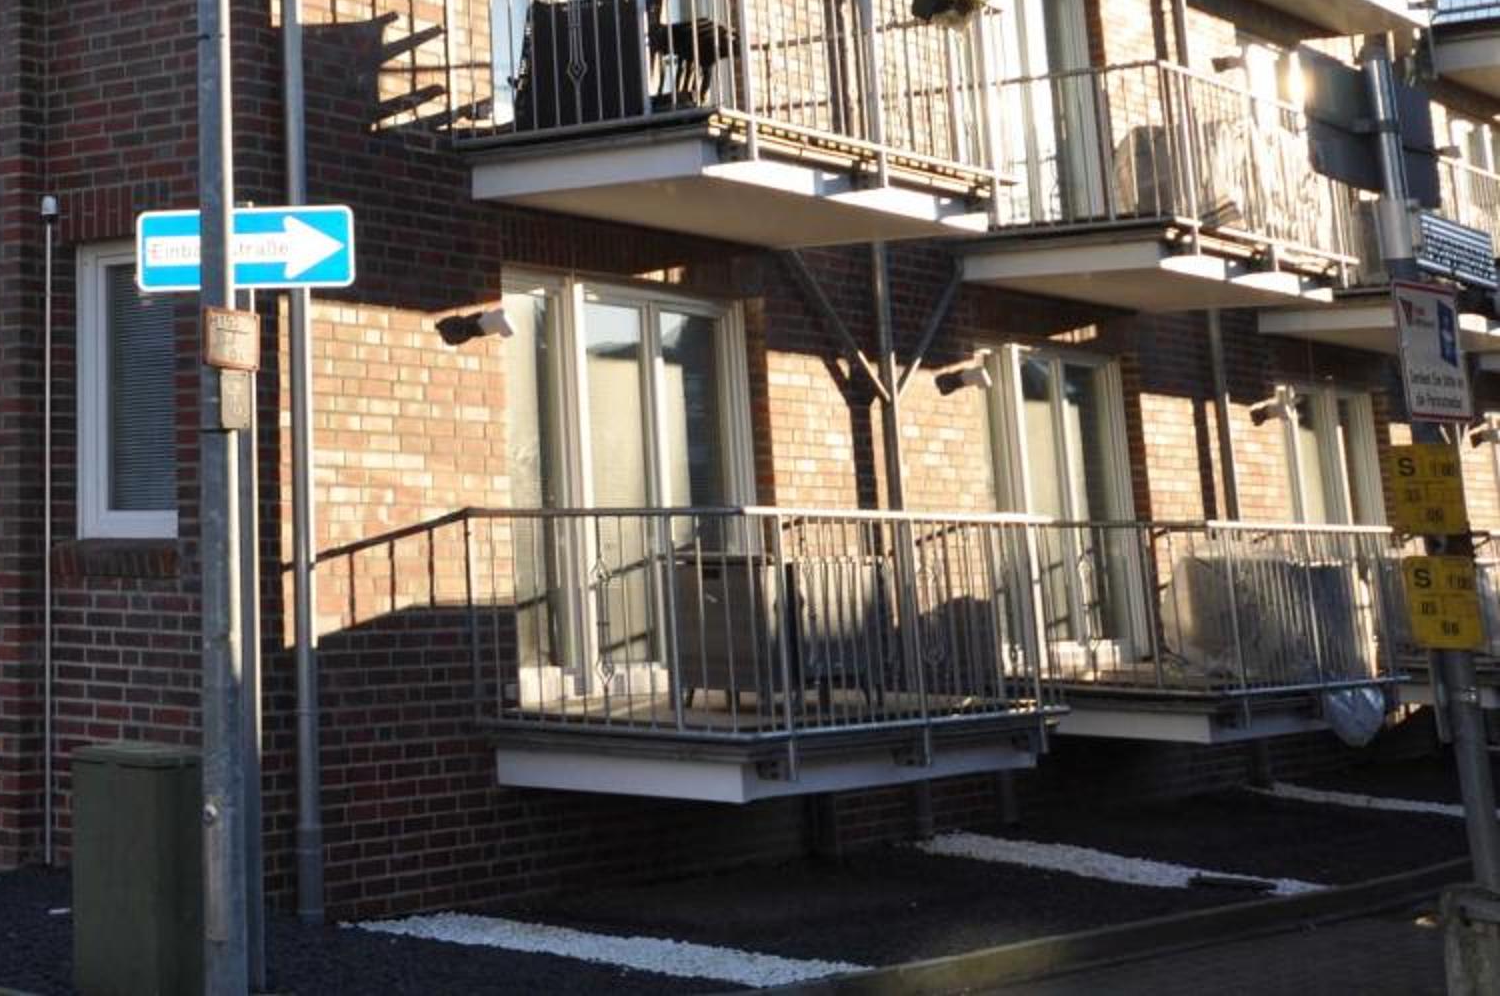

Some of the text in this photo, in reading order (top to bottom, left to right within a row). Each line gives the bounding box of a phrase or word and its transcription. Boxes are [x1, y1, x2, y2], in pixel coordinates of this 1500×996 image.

[151, 237, 289, 261] Einbatraße
[1398, 457, 1416, 476] S
[1414, 568, 1432, 589] S
